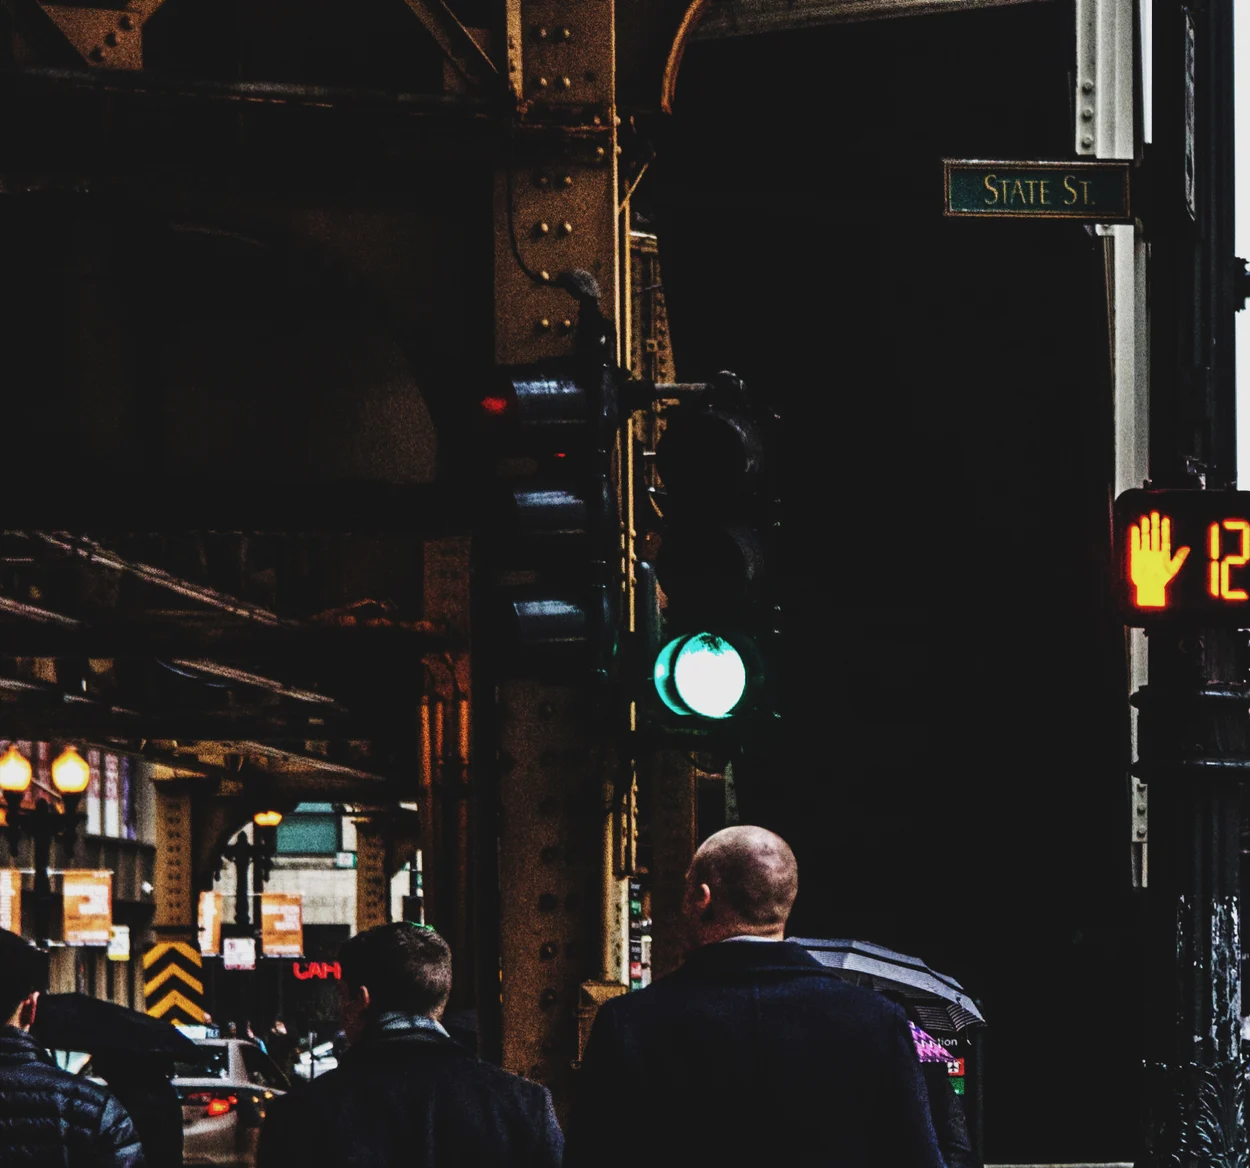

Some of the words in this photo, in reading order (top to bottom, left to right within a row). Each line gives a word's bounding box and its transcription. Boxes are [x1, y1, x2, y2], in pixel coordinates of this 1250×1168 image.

[984, 174, 1051, 205] STATE
[1064, 174, 1096, 205] ST.
[1209, 519, 1250, 601] 12
